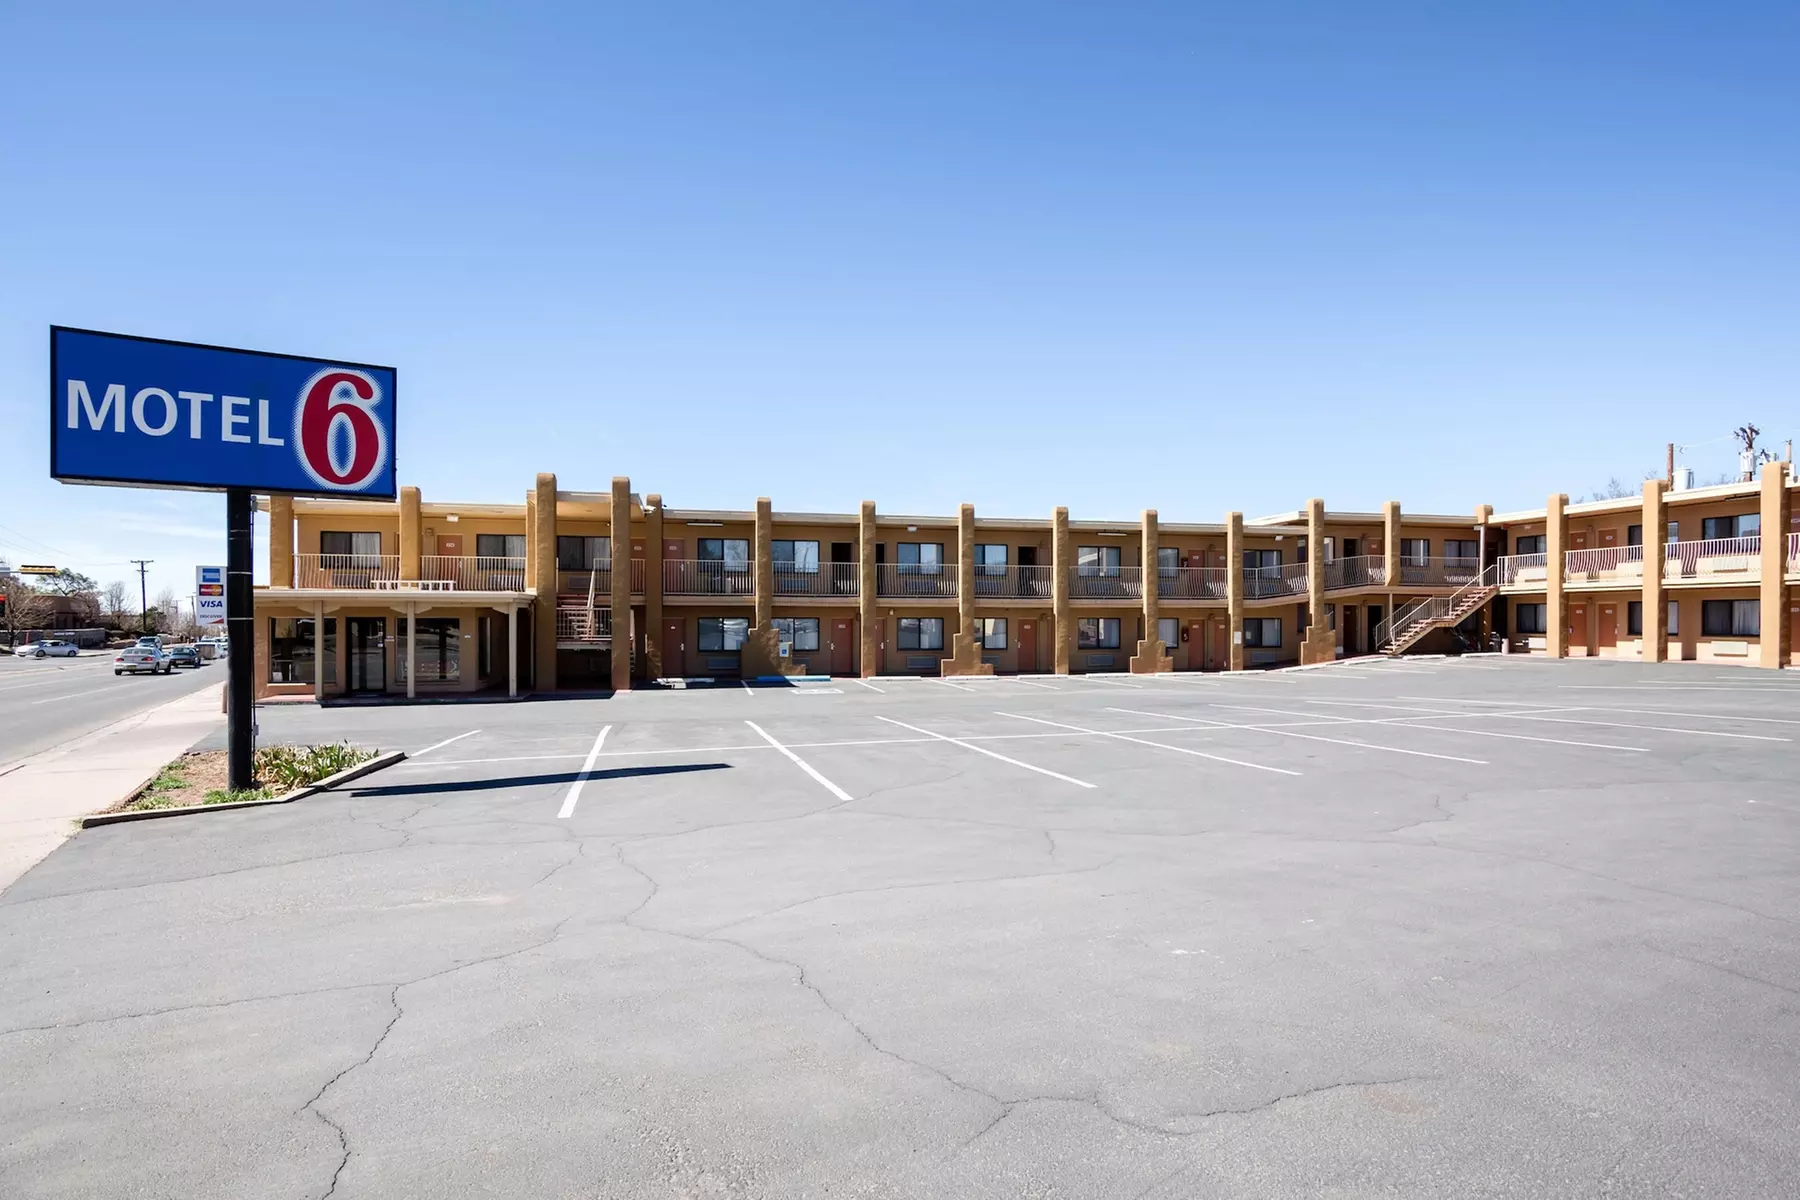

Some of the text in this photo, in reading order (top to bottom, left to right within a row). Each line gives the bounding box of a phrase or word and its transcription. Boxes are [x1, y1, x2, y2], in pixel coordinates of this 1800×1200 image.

[67, 369, 384, 488] MOTEL 6
[199, 600, 223, 608] VISA
